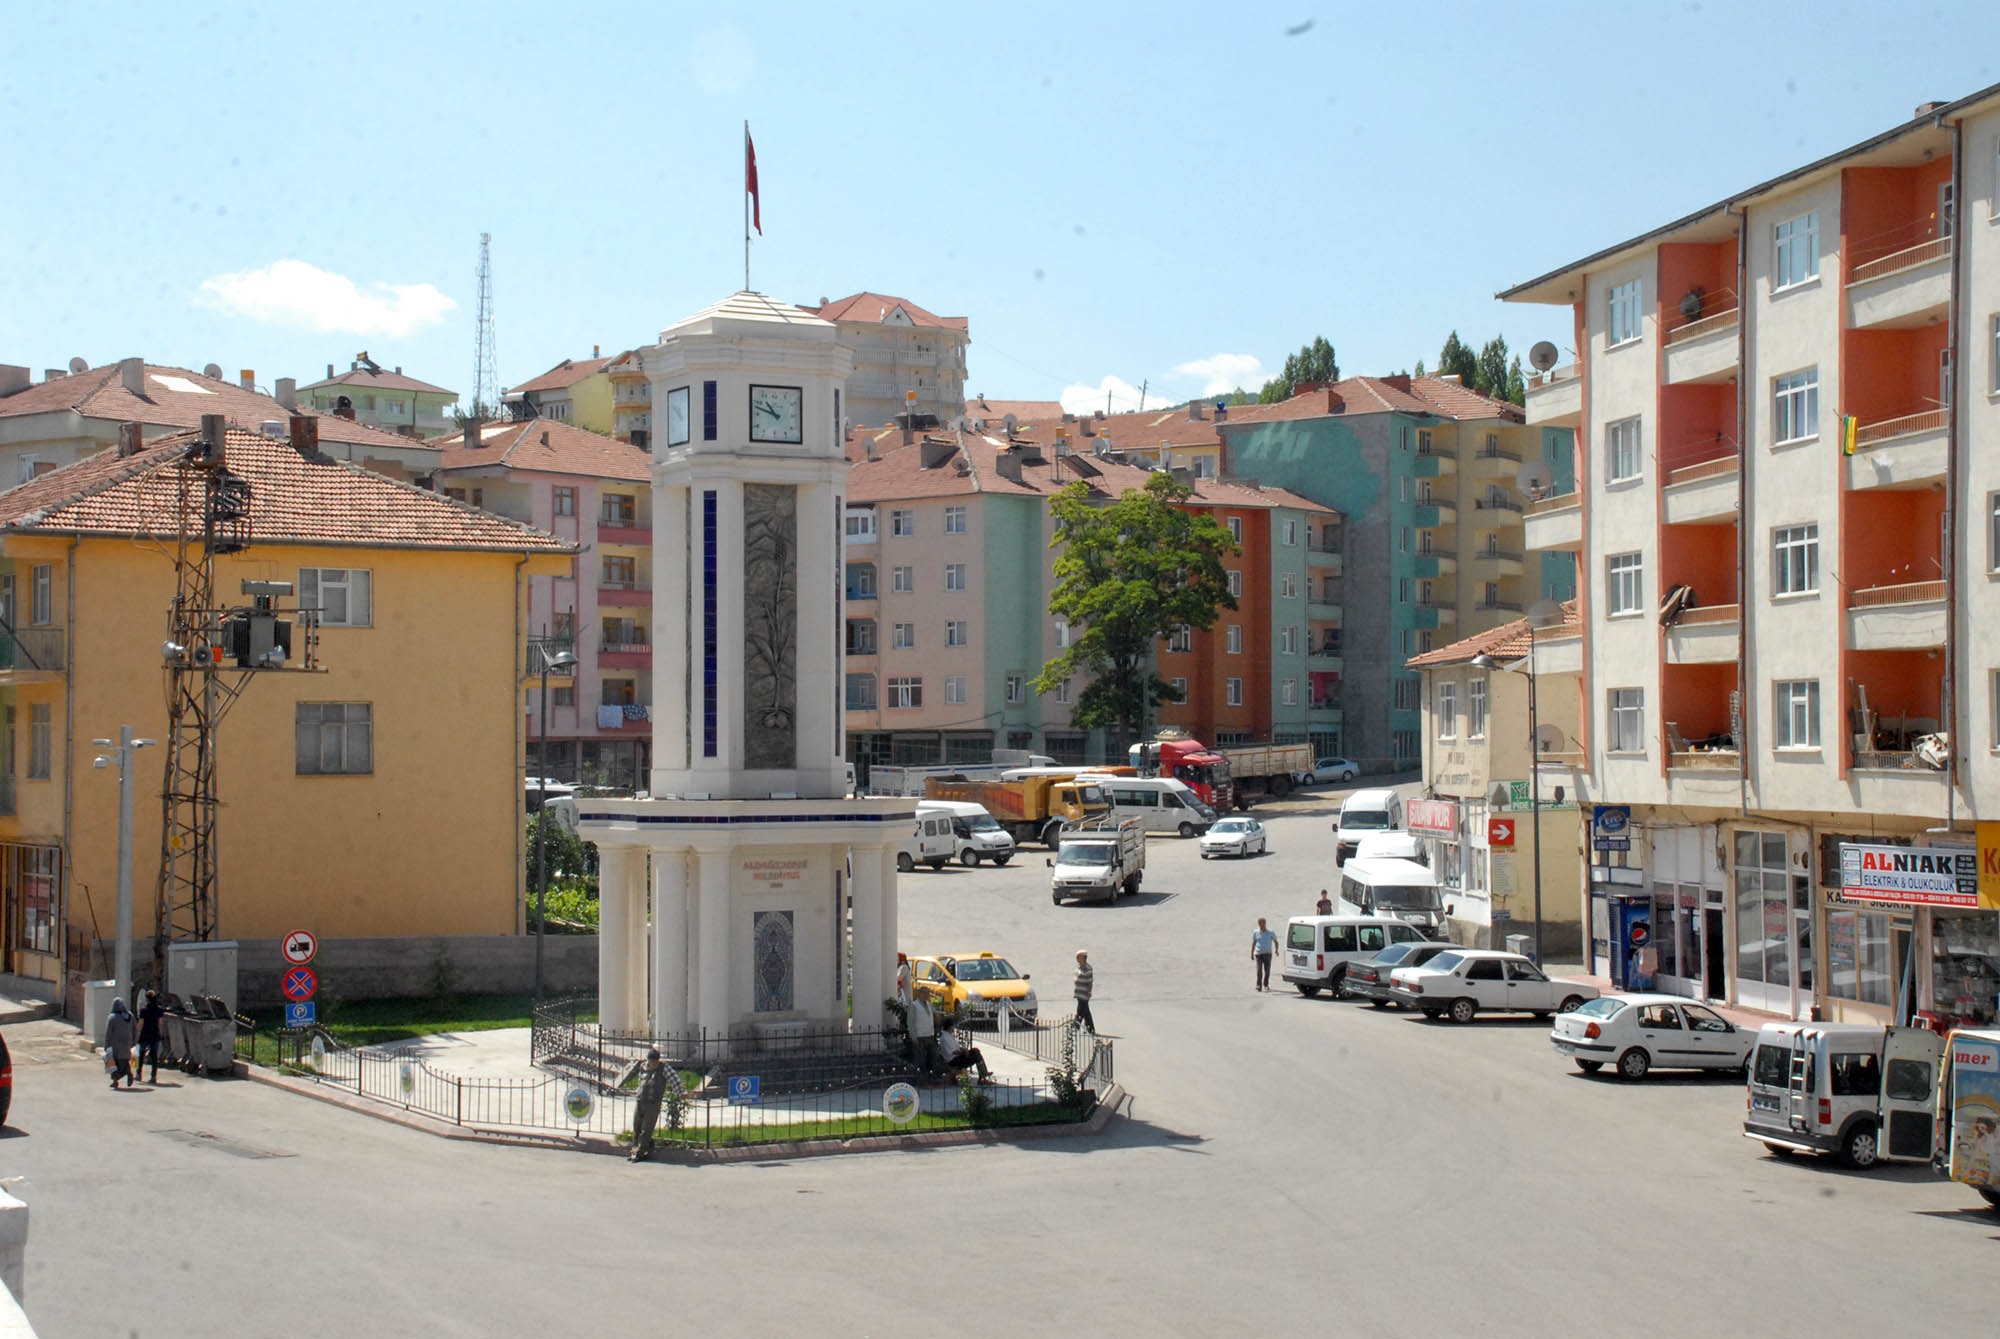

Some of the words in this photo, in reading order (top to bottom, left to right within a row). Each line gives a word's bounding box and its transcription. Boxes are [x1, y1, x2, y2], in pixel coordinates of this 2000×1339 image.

[1863, 852, 1953, 874] ALNIAK
[1901, 879, 1906, 888] &
[1955, 1052, 1991, 1065] mer
